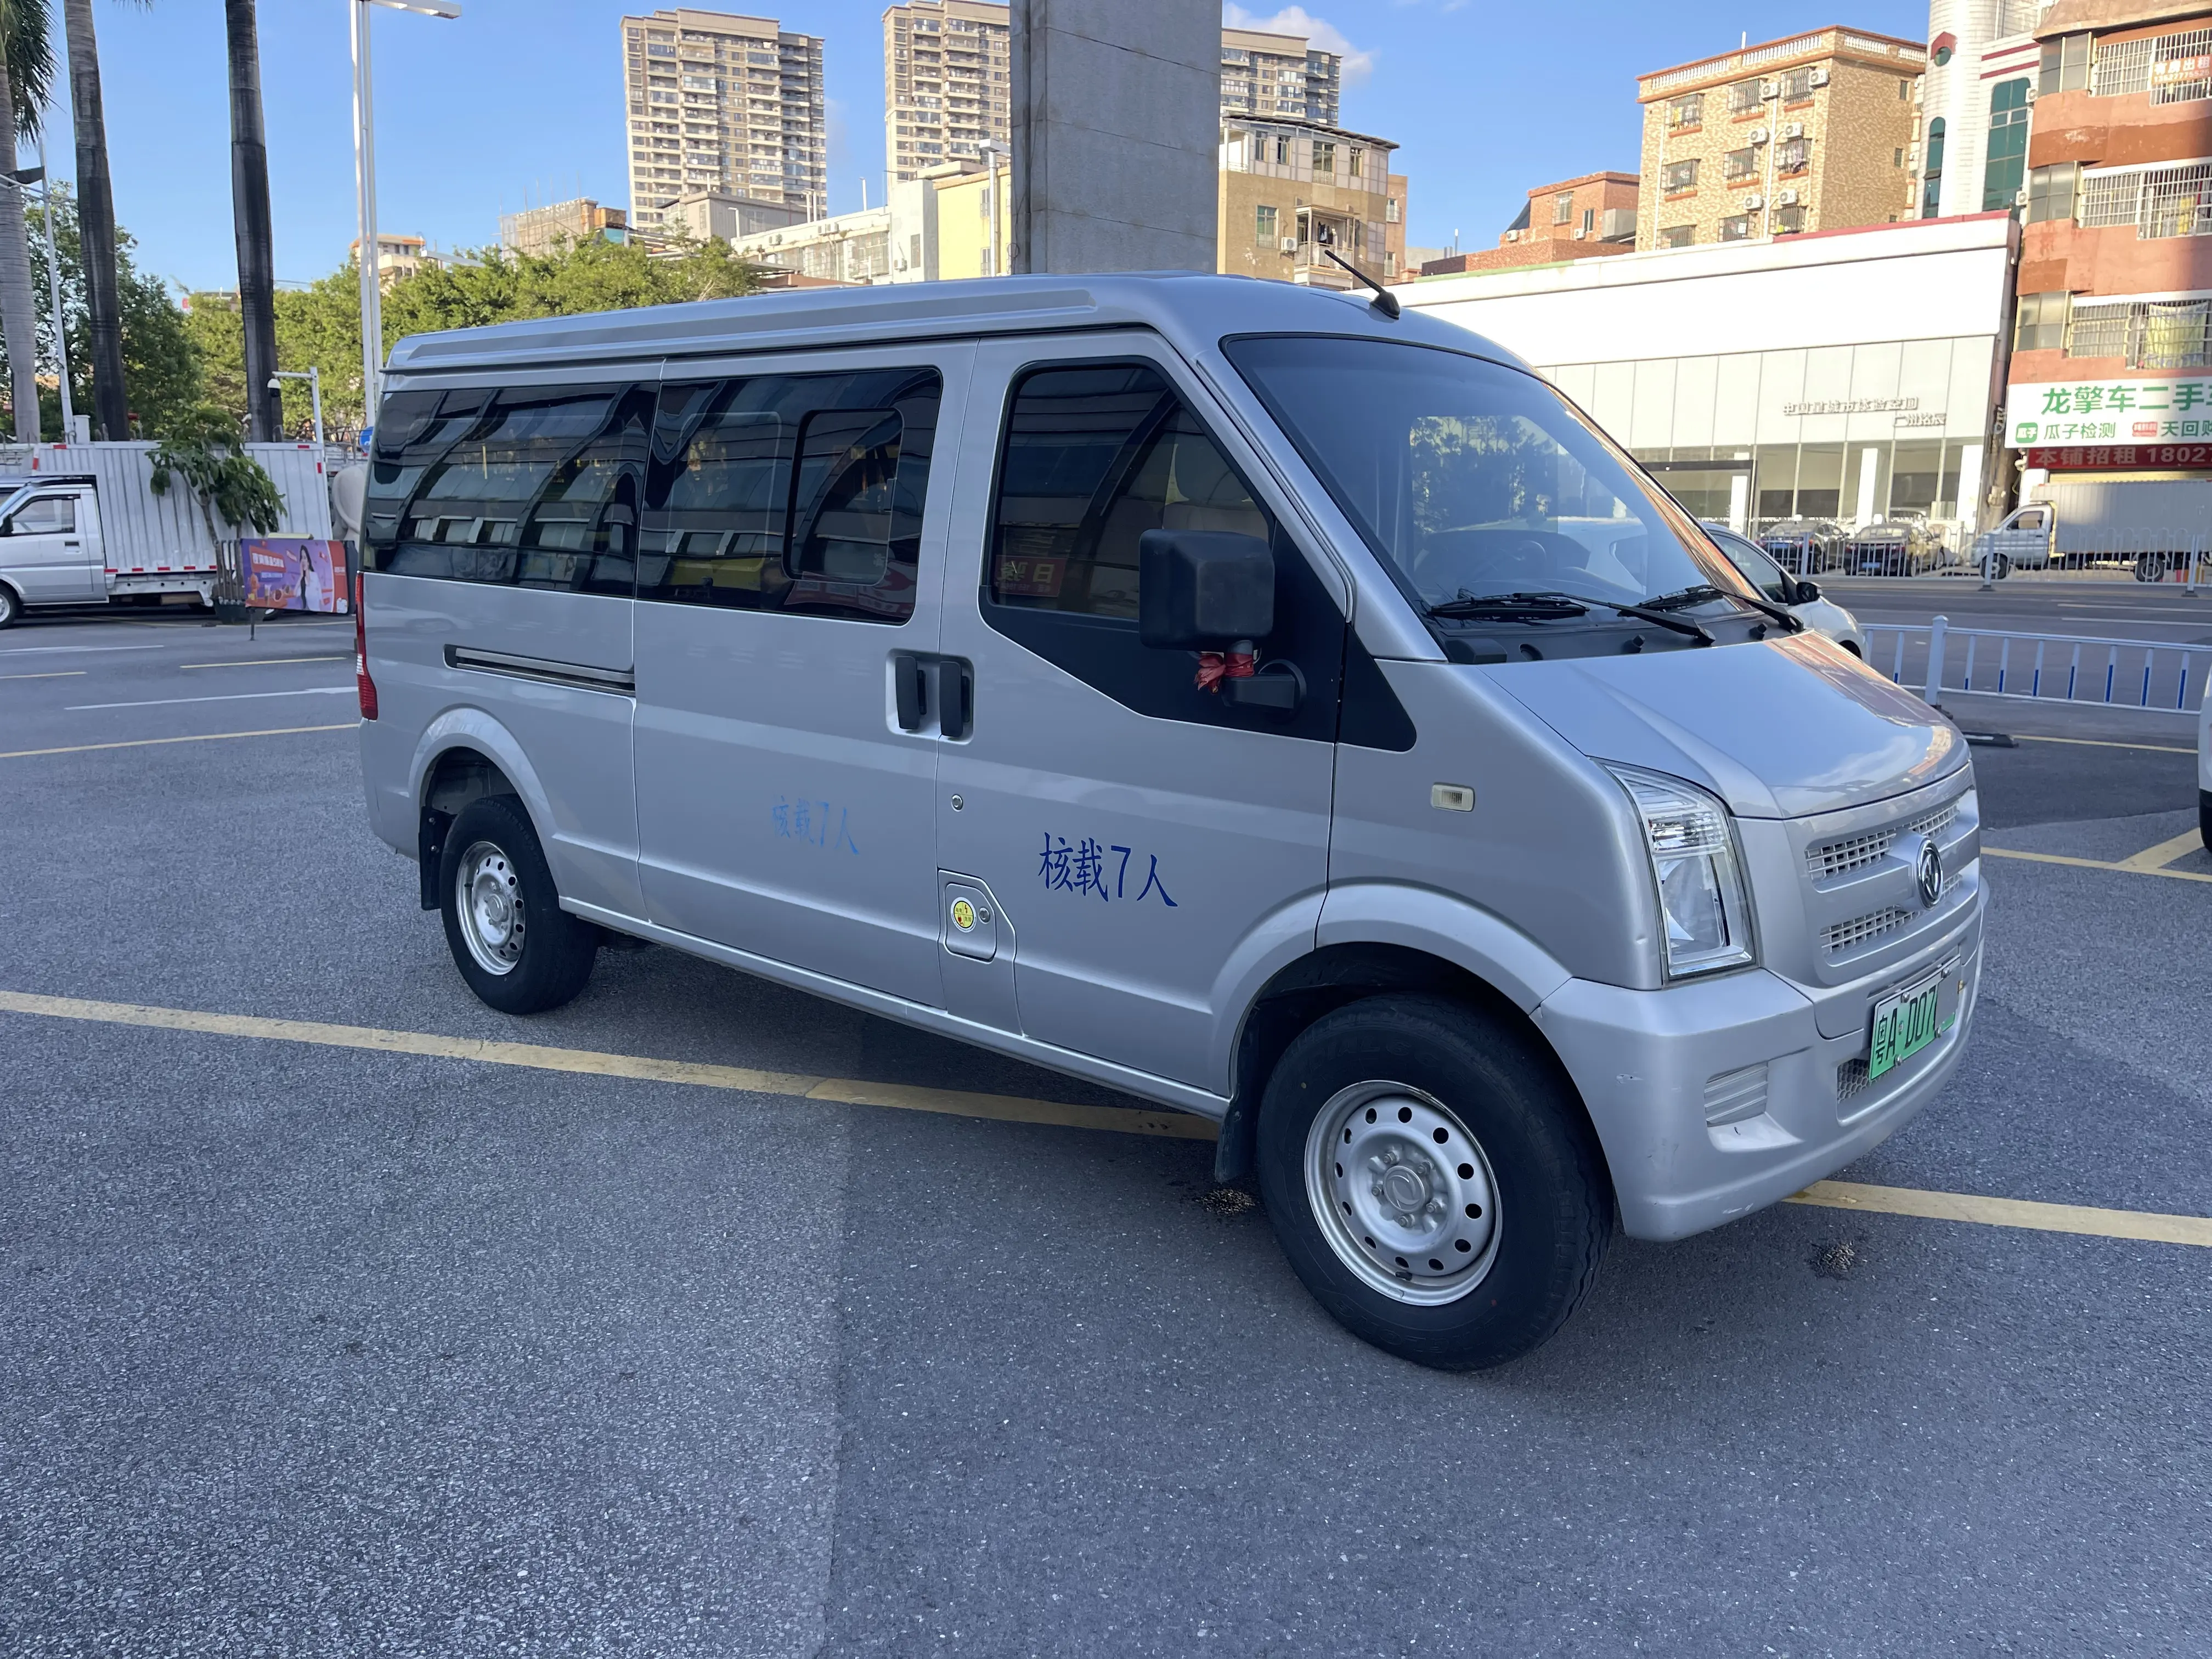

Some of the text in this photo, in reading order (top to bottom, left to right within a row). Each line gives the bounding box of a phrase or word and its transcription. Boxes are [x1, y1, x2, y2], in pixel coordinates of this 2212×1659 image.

[2041, 383, 2212, 415] 龙擎车二手
[2043, 422, 2116, 439] 瓜子检测
[2035, 447, 2212, 466] 本铺招租 1802
[1038, 832, 1178, 907] 核载7人
